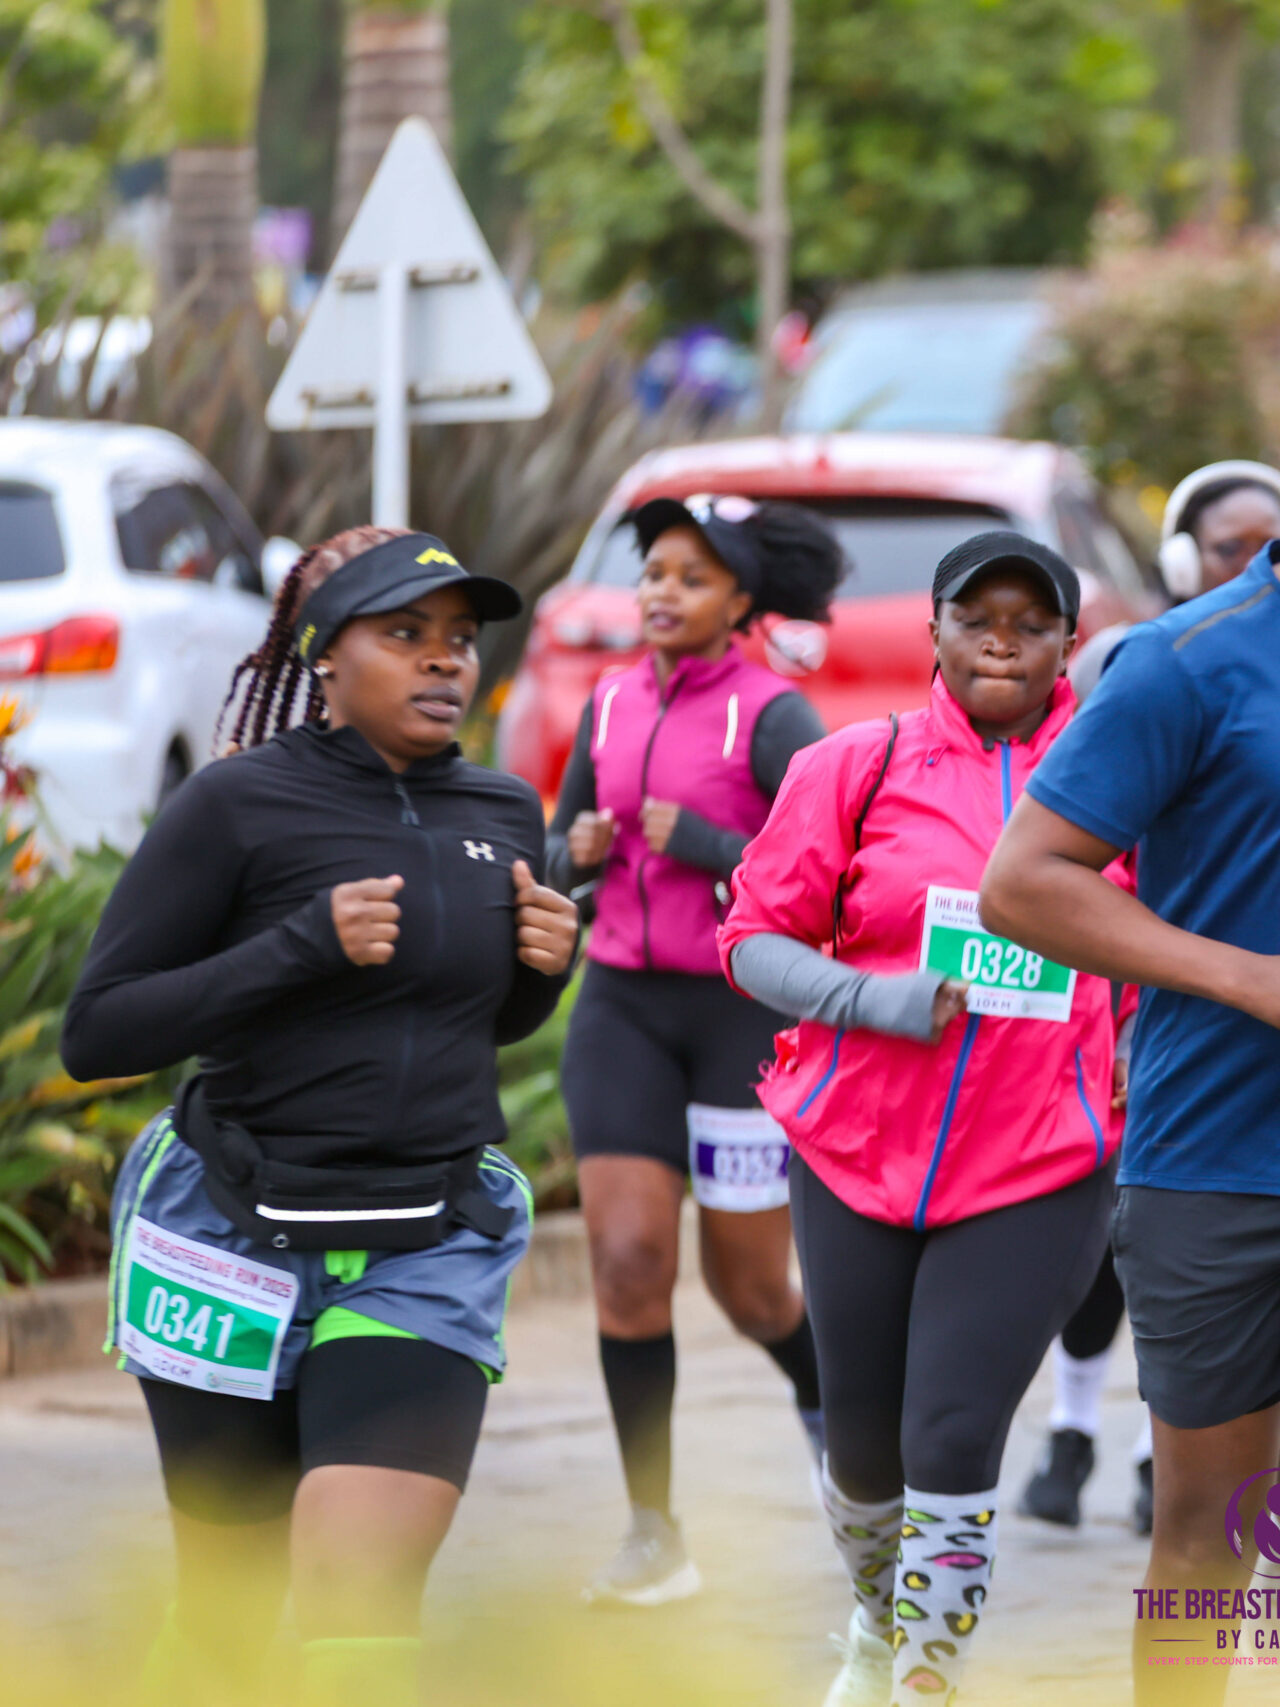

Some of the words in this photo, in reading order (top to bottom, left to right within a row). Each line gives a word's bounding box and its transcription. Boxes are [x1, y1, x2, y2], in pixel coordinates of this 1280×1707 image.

[935, 896, 952, 910] THE
[961, 938, 1044, 988] 0328
[976, 997, 1010, 1011] 10KM
[152, 1235, 234, 1279] BREASTFEEDING
[235, 1266, 260, 1287] RUN
[261, 1275, 294, 1299] 2025
[144, 1286, 235, 1359] 0341
